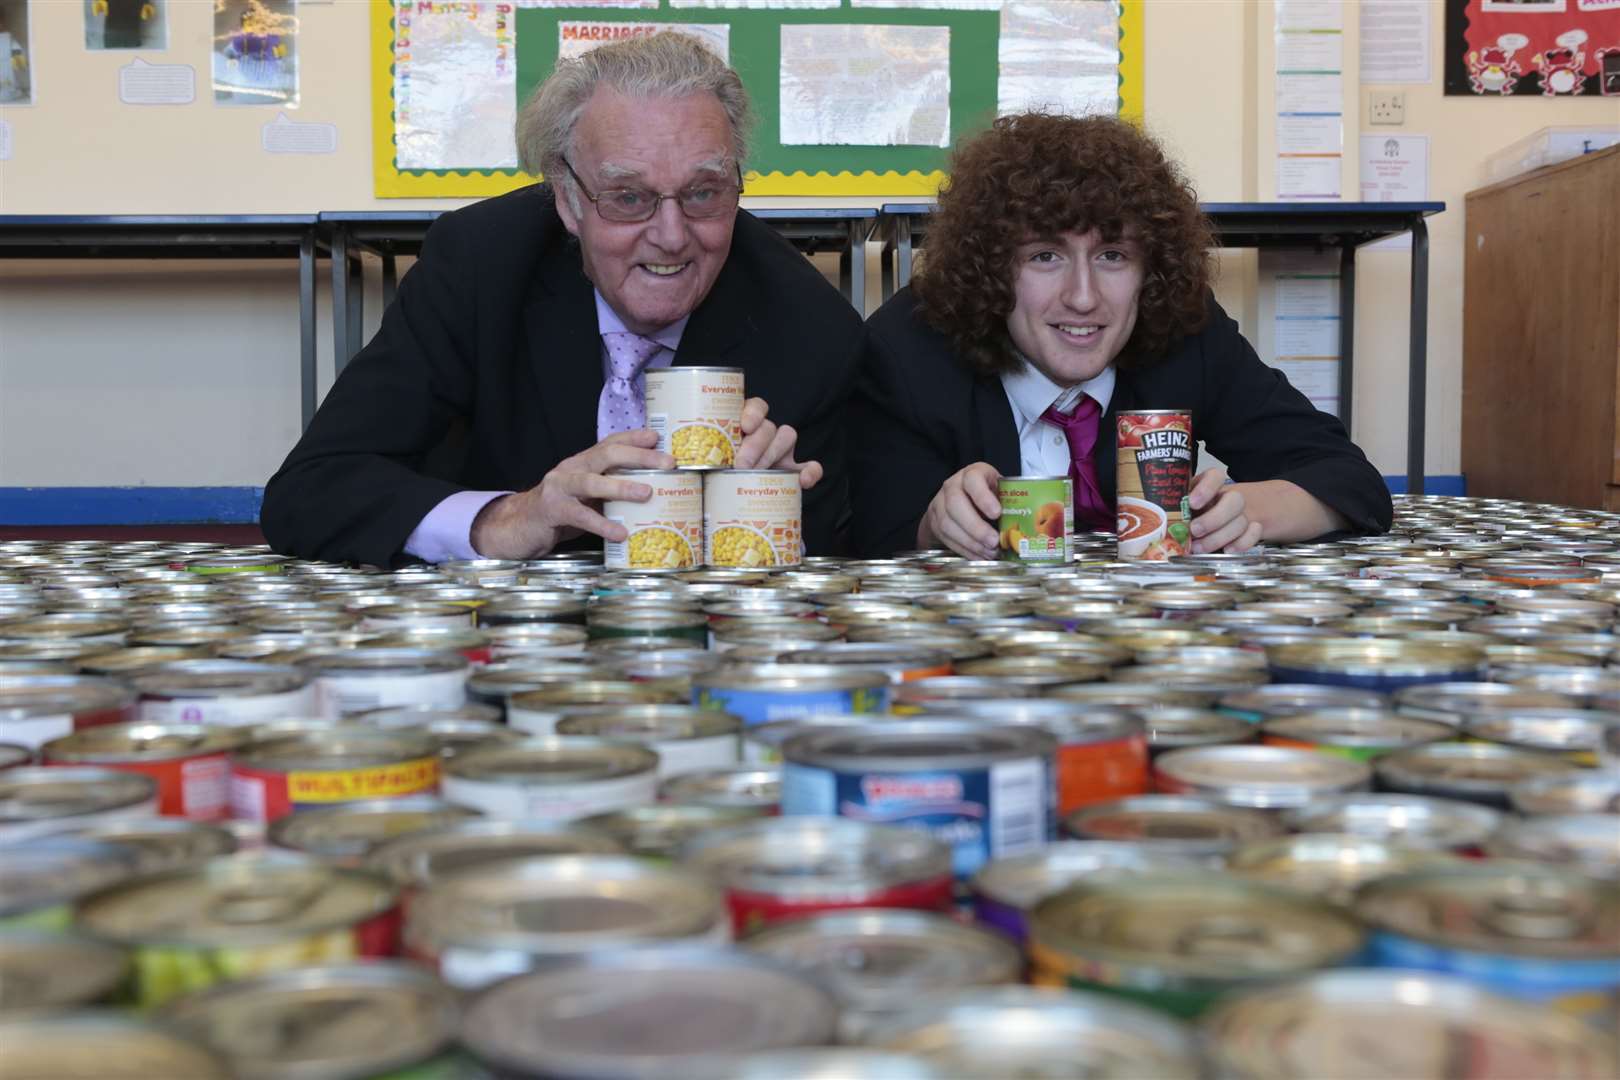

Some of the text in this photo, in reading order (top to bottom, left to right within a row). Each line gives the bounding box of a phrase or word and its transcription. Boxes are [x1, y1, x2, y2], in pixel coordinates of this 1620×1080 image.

[1145, 431, 1188, 448] HEINZ
[1137, 447, 1191, 462] FARMERS' MARK
[736, 487, 779, 497] Everyday
